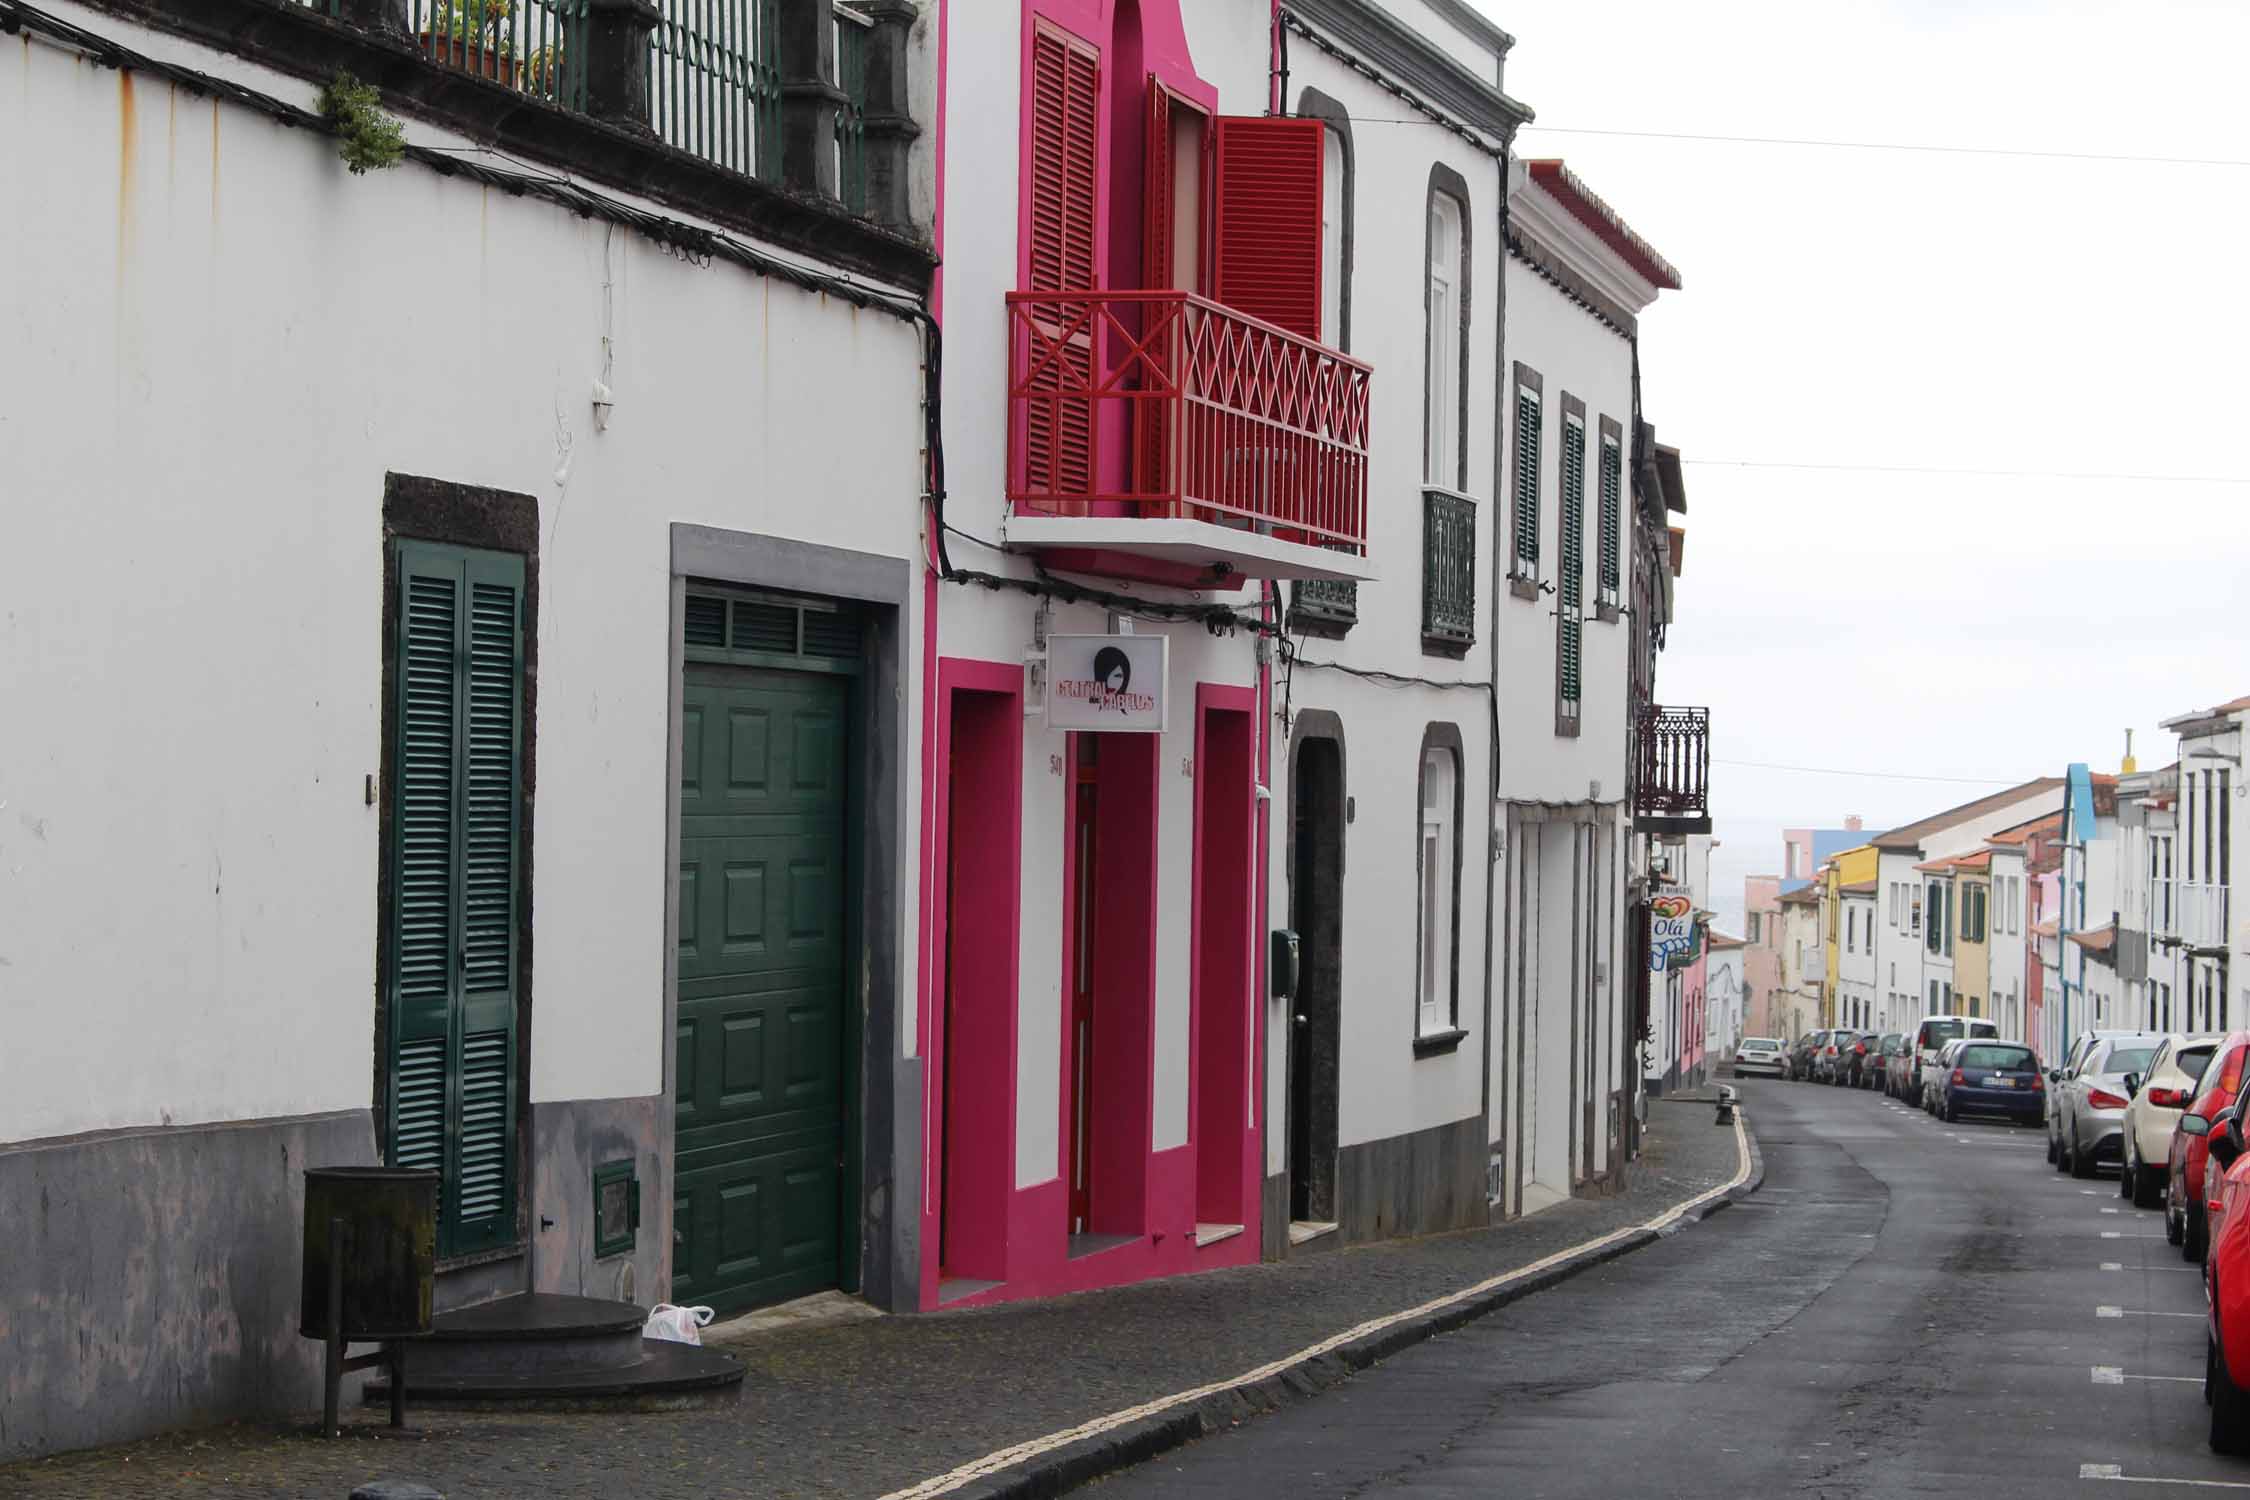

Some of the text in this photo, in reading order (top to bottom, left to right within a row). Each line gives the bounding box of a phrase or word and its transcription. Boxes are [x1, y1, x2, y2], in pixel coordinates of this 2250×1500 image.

[1056, 680, 1107, 698] CENTRAL
[1101, 692, 1155, 711] CABELOS
[1654, 919, 1684, 936] Olá
